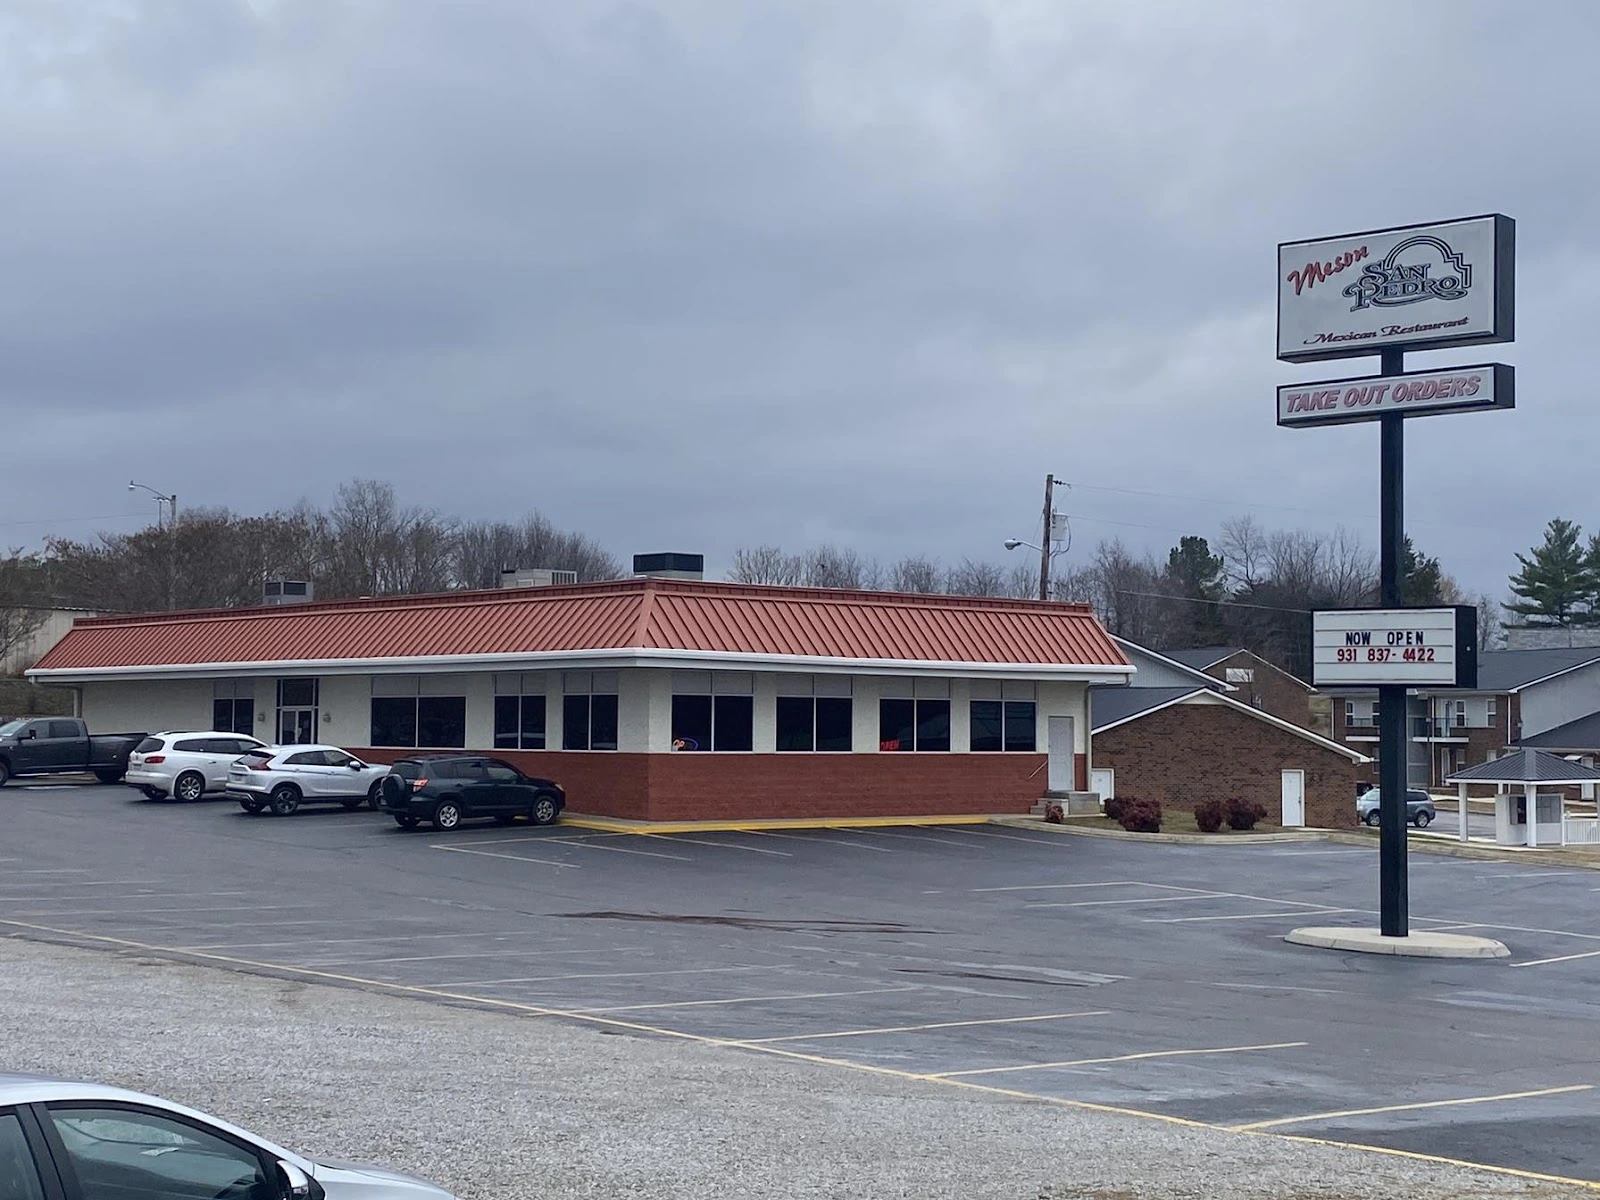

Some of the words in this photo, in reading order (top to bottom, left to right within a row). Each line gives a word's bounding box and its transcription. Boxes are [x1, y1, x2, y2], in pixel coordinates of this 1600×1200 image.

[1287, 246, 1369, 296] Meson
[1361, 260, 1431, 284] SAN
[1342, 275, 1468, 312] PEDRO
[1303, 330, 1377, 345] Mexican
[1381, 316, 1470, 337] Restaurant
[1286, 389, 1340, 413] TAKE
[1344, 384, 1390, 408] OUT
[1391, 375, 1481, 402] ORDERS
[1345, 631, 1371, 646] NOW
[1387, 631, 1424, 646] OPEN
[1337, 648, 1357, 662] 931
[1402, 648, 1435, 662] 4422
